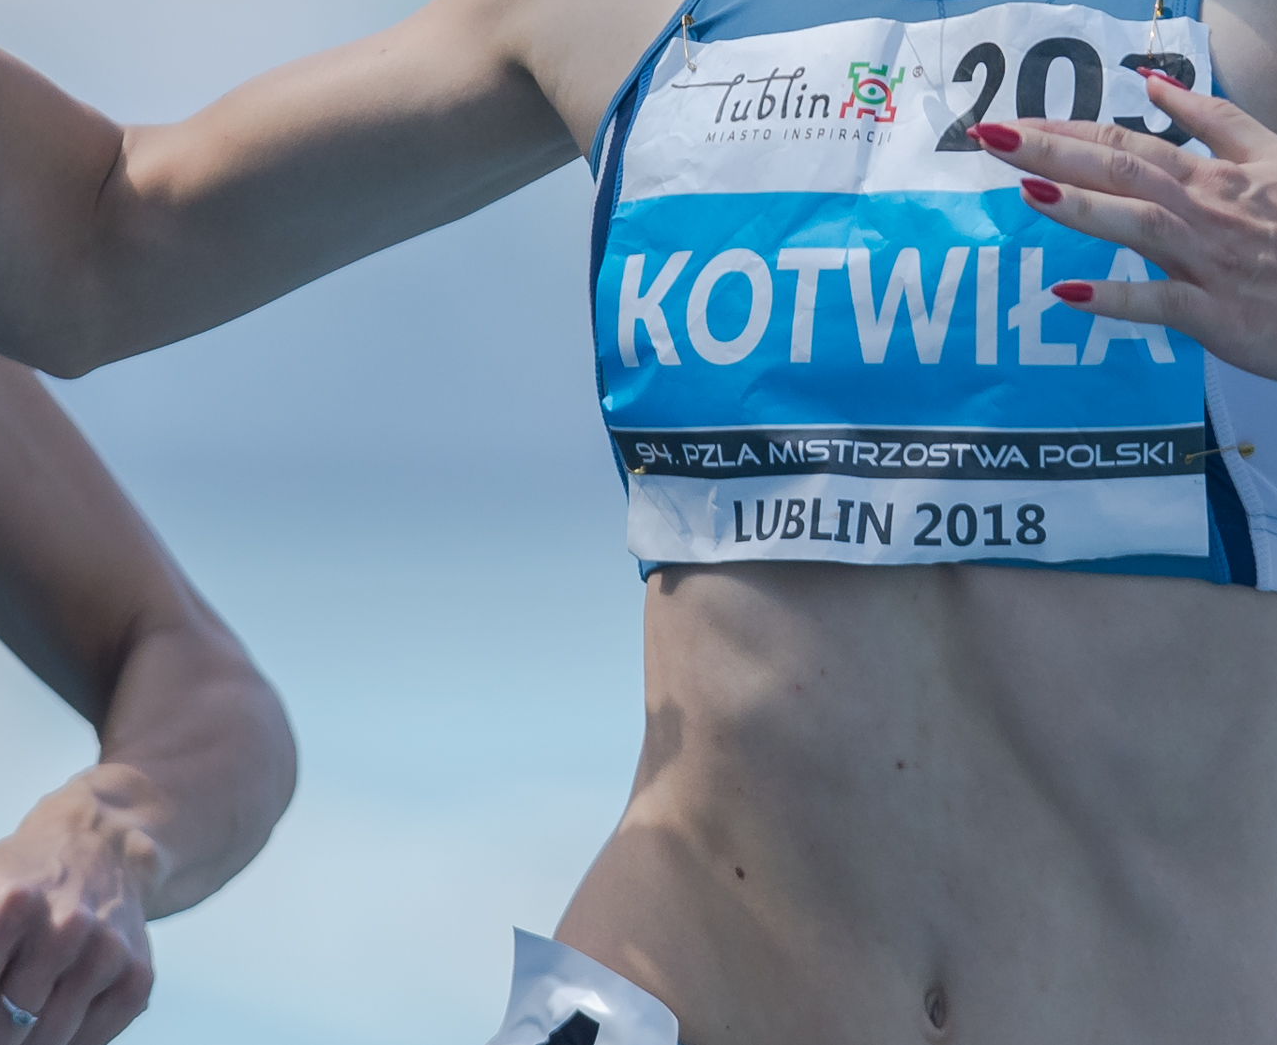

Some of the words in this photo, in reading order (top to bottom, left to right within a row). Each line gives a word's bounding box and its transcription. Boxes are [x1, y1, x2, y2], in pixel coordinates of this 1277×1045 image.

[672, 67, 830, 124] lublin
[705, 129, 772, 143] MIASTO
[783, 127, 892, 146] INSPIRACJI
[617, 246, 1176, 367] KOTWIŁA
[635, 442, 680, 465] 94.
[682, 443, 761, 467] PZLA
[768, 439, 1030, 468] MISTRZOSTWA
[1039, 441, 1174, 468] POLSKI
[733, 497, 894, 546] LUBLIN
[914, 503, 1047, 547] 2018
